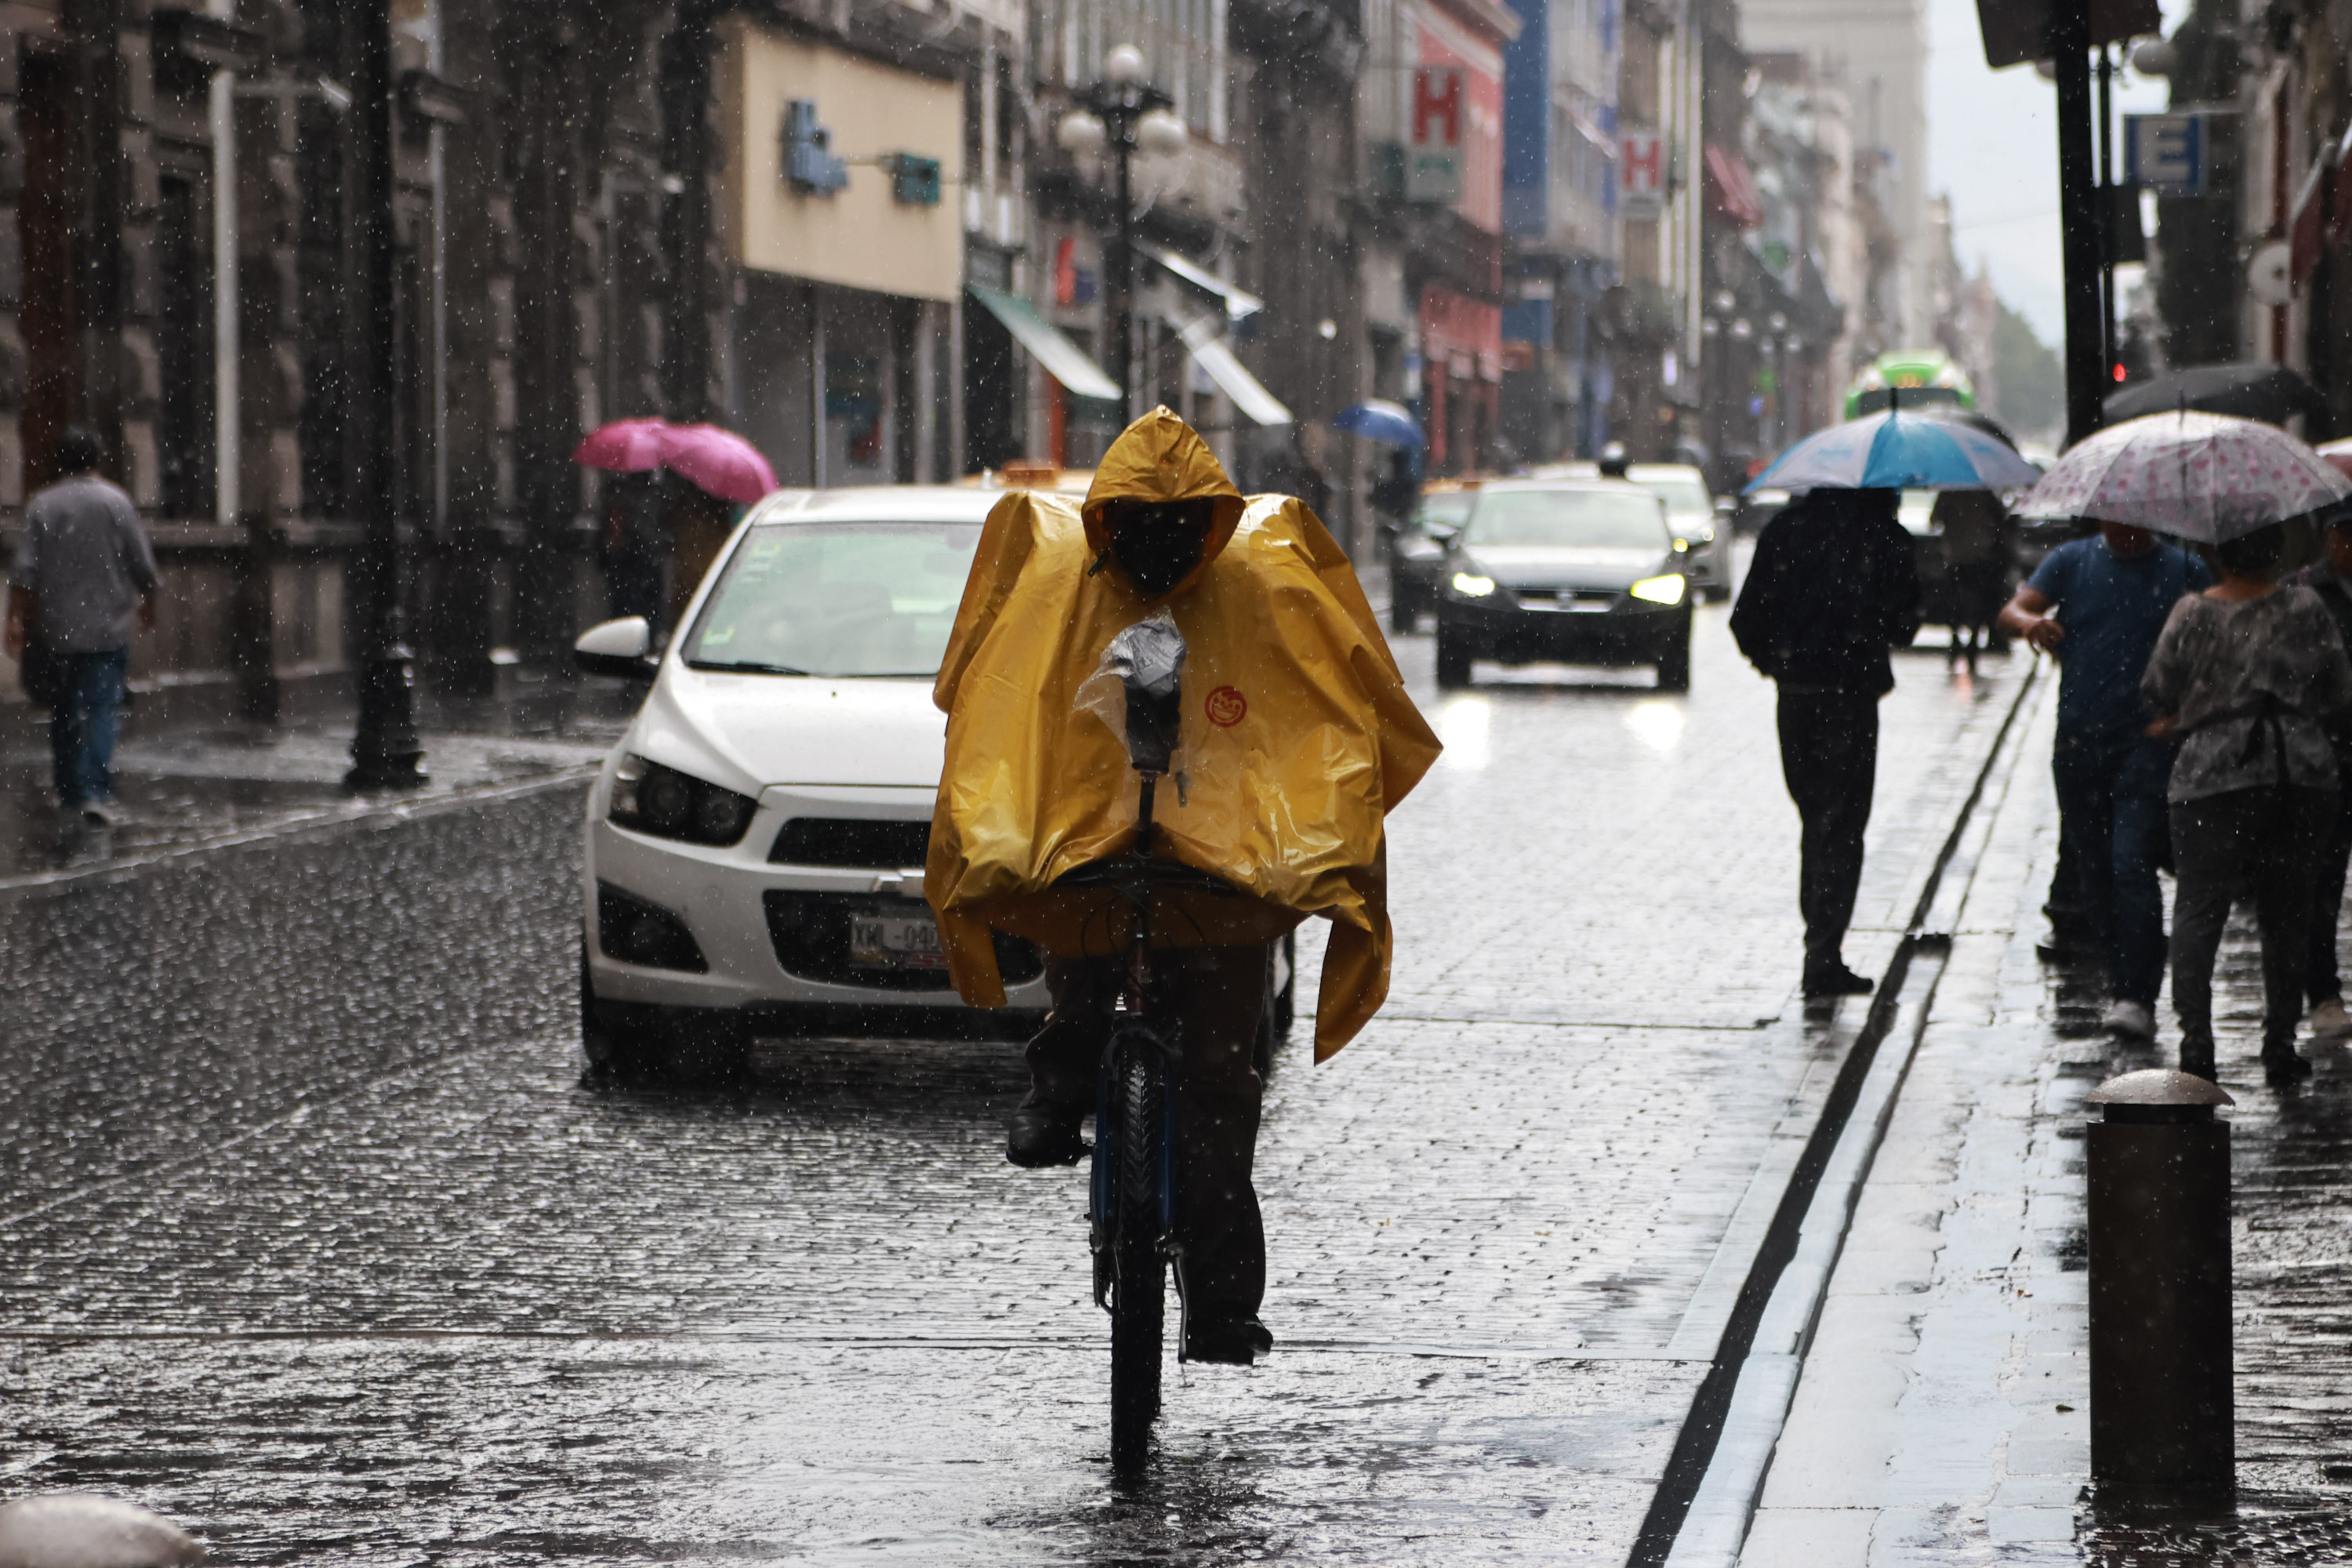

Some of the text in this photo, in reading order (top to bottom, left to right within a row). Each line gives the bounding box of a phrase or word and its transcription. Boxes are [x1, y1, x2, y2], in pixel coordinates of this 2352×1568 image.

[1414, 71, 1459, 147] H
[1623, 139, 1660, 188] H
[2137, 118, 2189, 181] E
